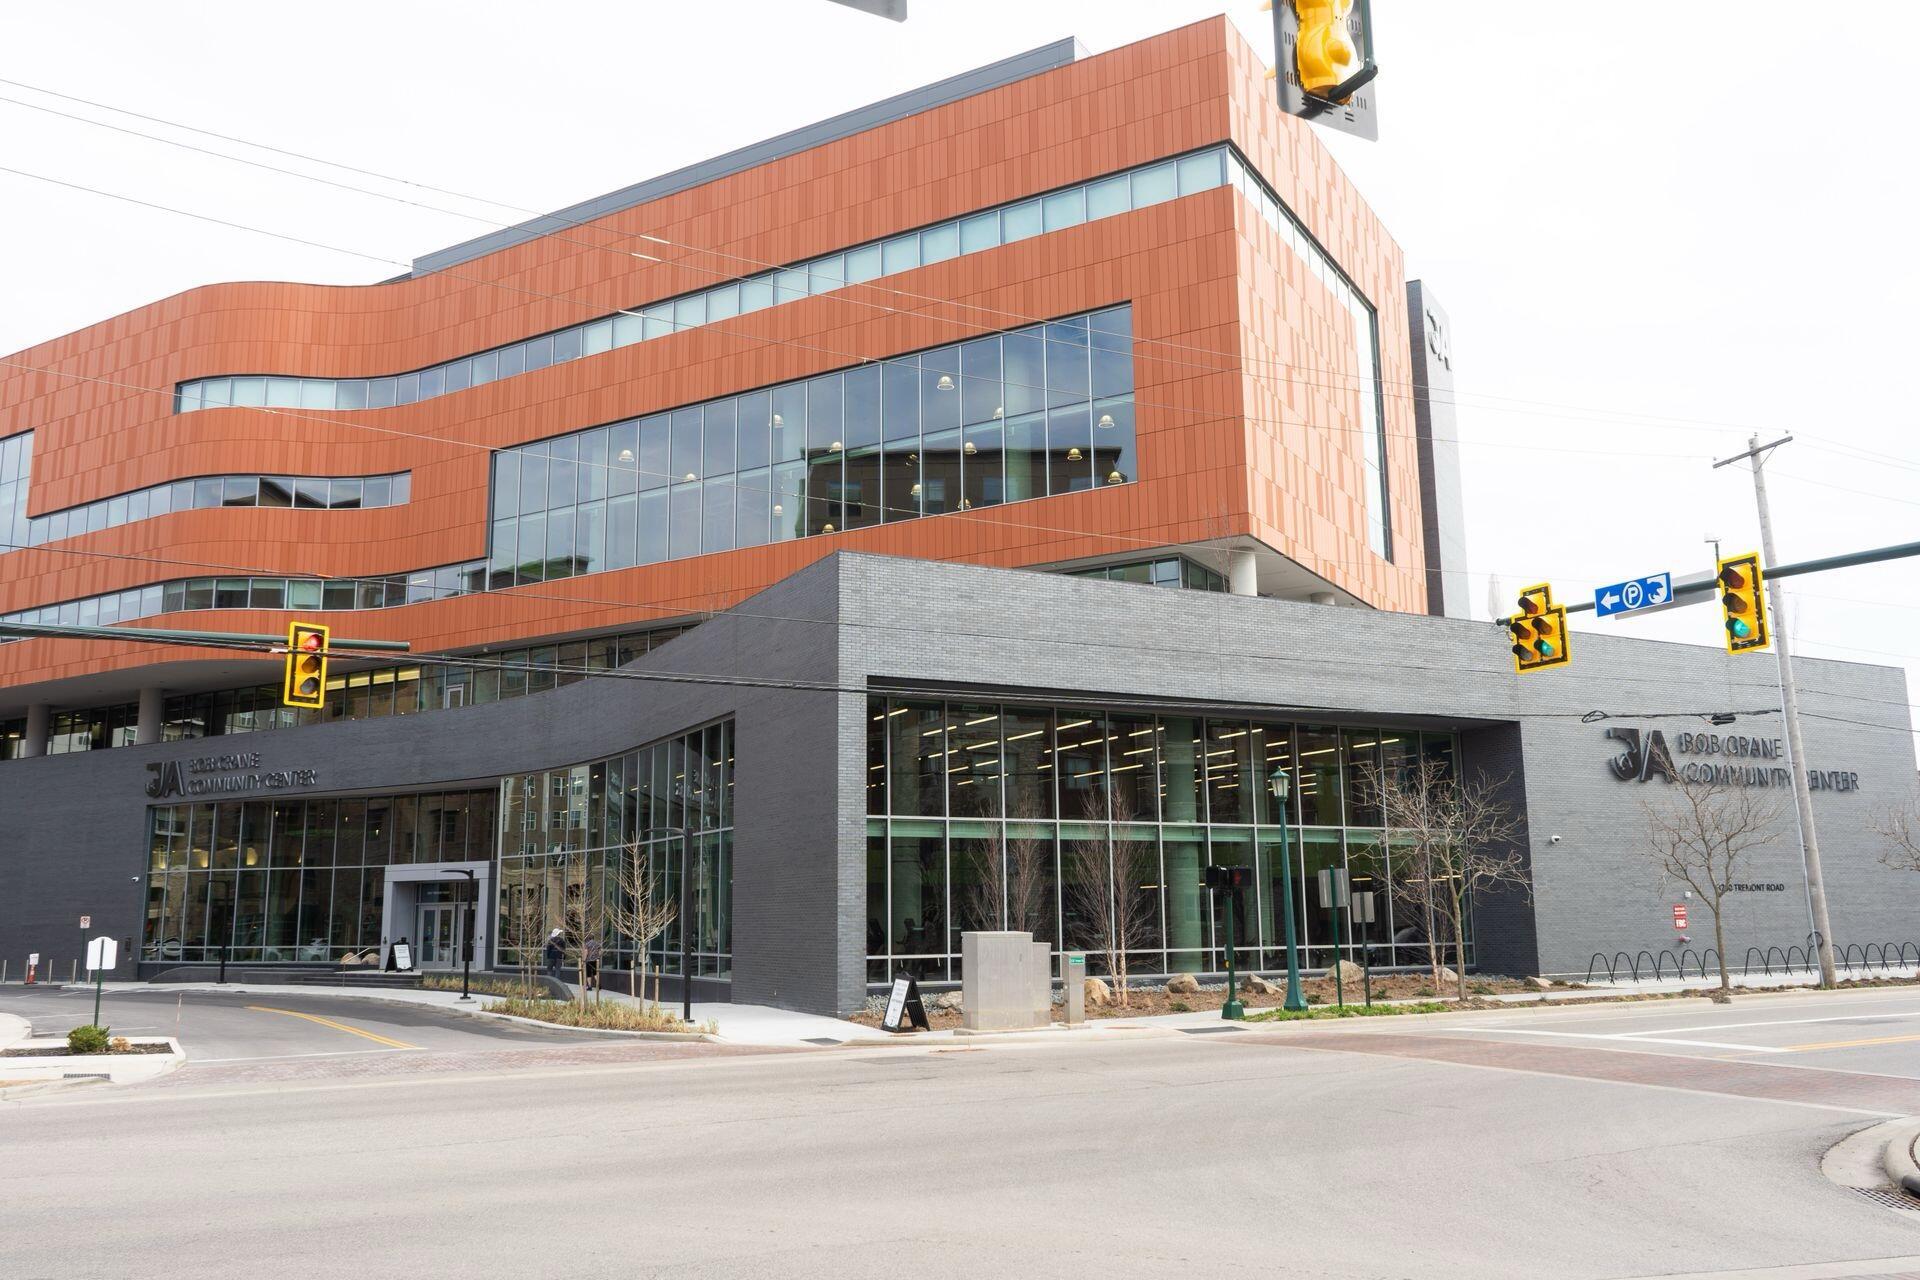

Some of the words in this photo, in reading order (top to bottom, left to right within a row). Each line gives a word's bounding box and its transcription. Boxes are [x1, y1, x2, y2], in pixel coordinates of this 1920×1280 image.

[1627, 586, 1639, 604] P
[1680, 732, 1721, 754] BOB
[1723, 735, 1784, 759] CRANE
[189, 757, 216, 774] BOB
[217, 752, 261, 772] CRANE
[187, 774, 262, 796] COMMUNITY
[264, 769, 317, 789] CENTER
[1683, 762, 1792, 788] COMMUNITY
[1804, 769, 1860, 792] ENTER
[1766, 883, 1785, 892] ROAD
